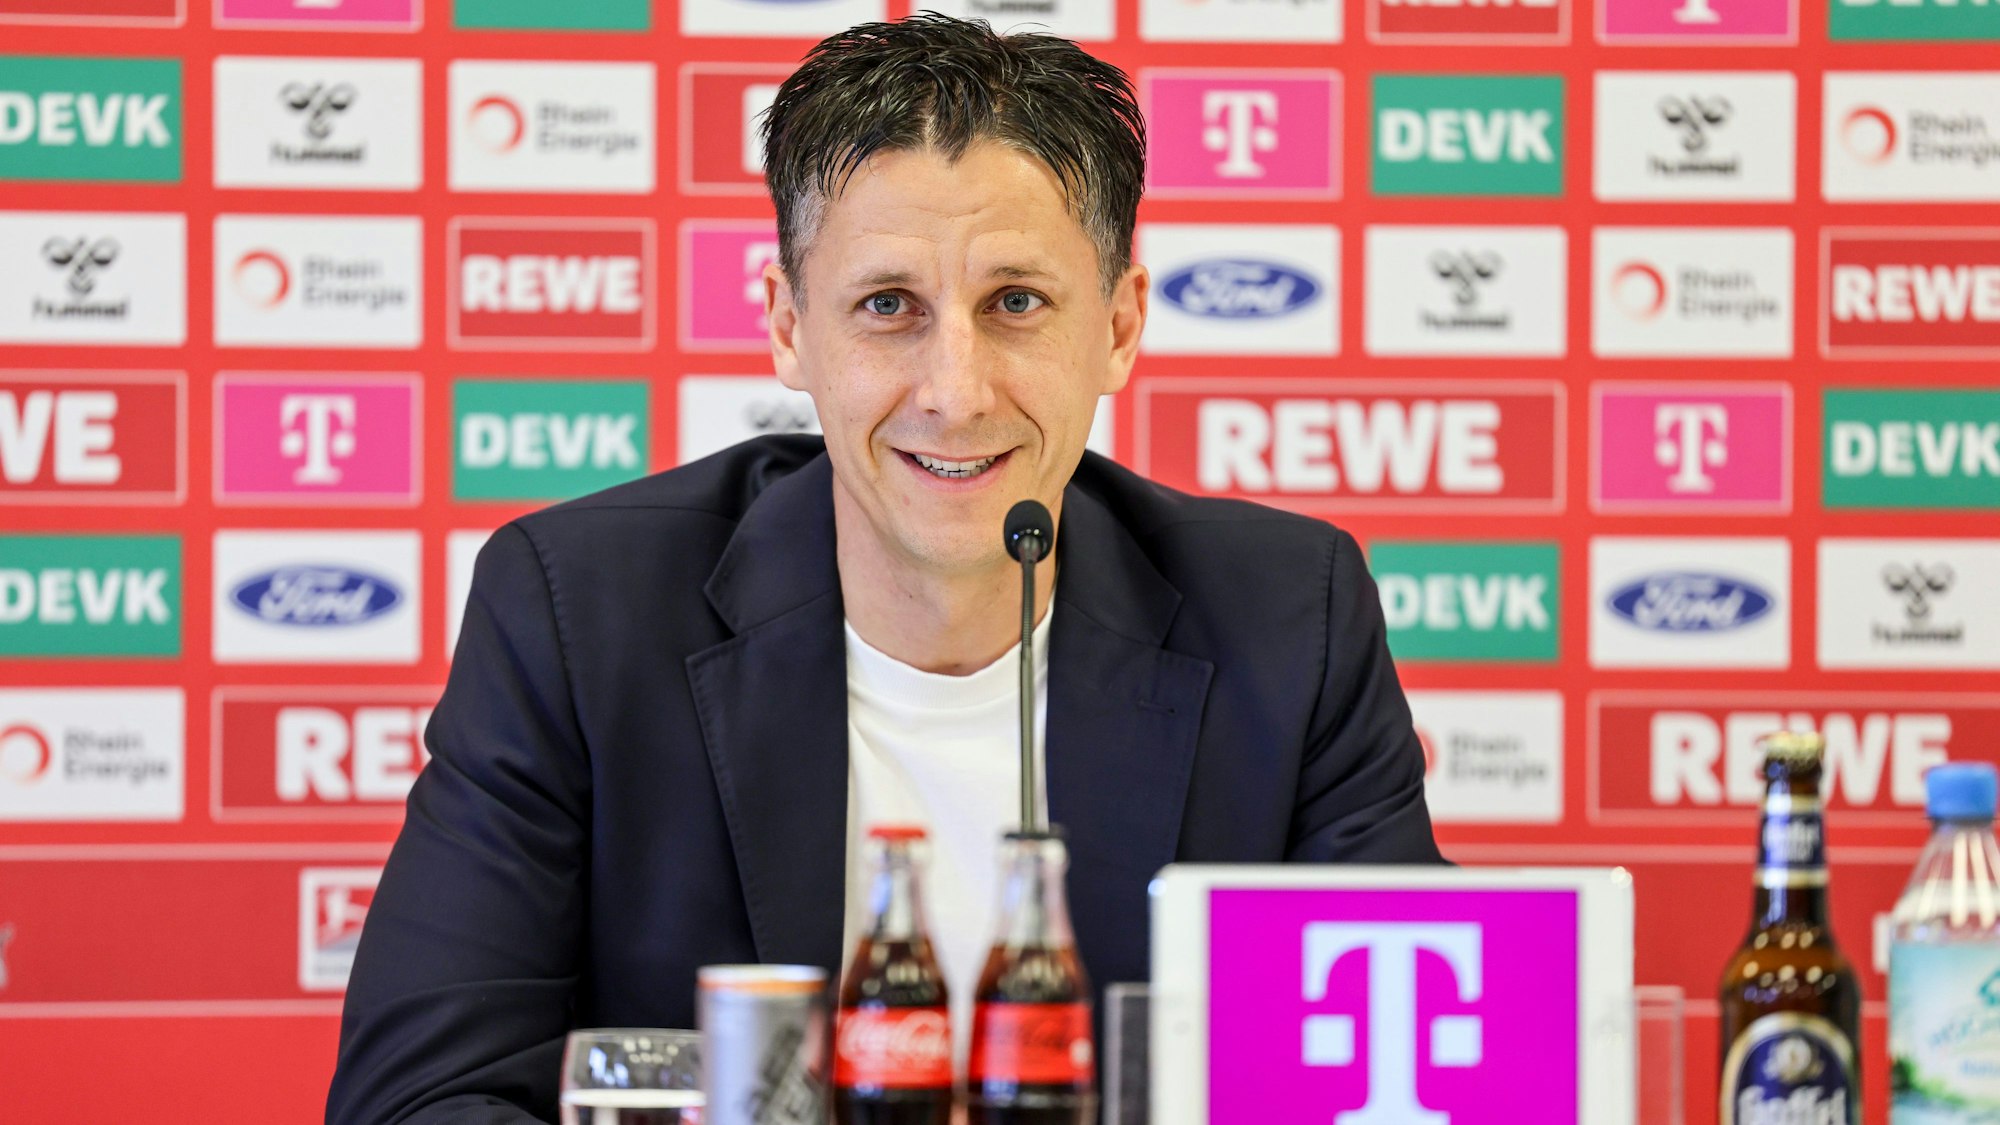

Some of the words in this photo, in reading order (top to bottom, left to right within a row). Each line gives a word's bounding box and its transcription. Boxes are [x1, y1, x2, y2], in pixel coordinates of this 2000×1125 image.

[0, 91, 171, 147] DEVK
[535, 100, 615, 127] Rhein
[1379, 108, 1554, 162] DEVK
[270, 141, 365, 165] hummel
[535, 130, 640, 157] Energie
[1648, 155, 1740, 177] hummel
[1907, 139, 2000, 168] Energi
[301, 255, 381, 281] Rhein
[460, 255, 642, 313] REWE
[1180, 262, 1296, 316] Ford
[1832, 265, 2000, 321] REWE
[32, 297, 128, 320] hummel
[301, 285, 407, 313] Energie
[1421, 310, 1511, 332] hummel
[0, 391, 121, 484] WE
[461, 413, 639, 468] DEVK
[1198, 399, 1503, 492] REWE
[1831, 422, 2000, 477] DEVK
[0, 569, 170, 624] DEVK
[258, 567, 375, 623] Ford
[1379, 574, 1548, 629] DEVK
[1632, 574, 1746, 630] Ford
[1872, 622, 1964, 645] hummel
[63, 727, 145, 752] Rhein
[276, 707, 433, 801] RE
[63, 756, 170, 785] Energie
